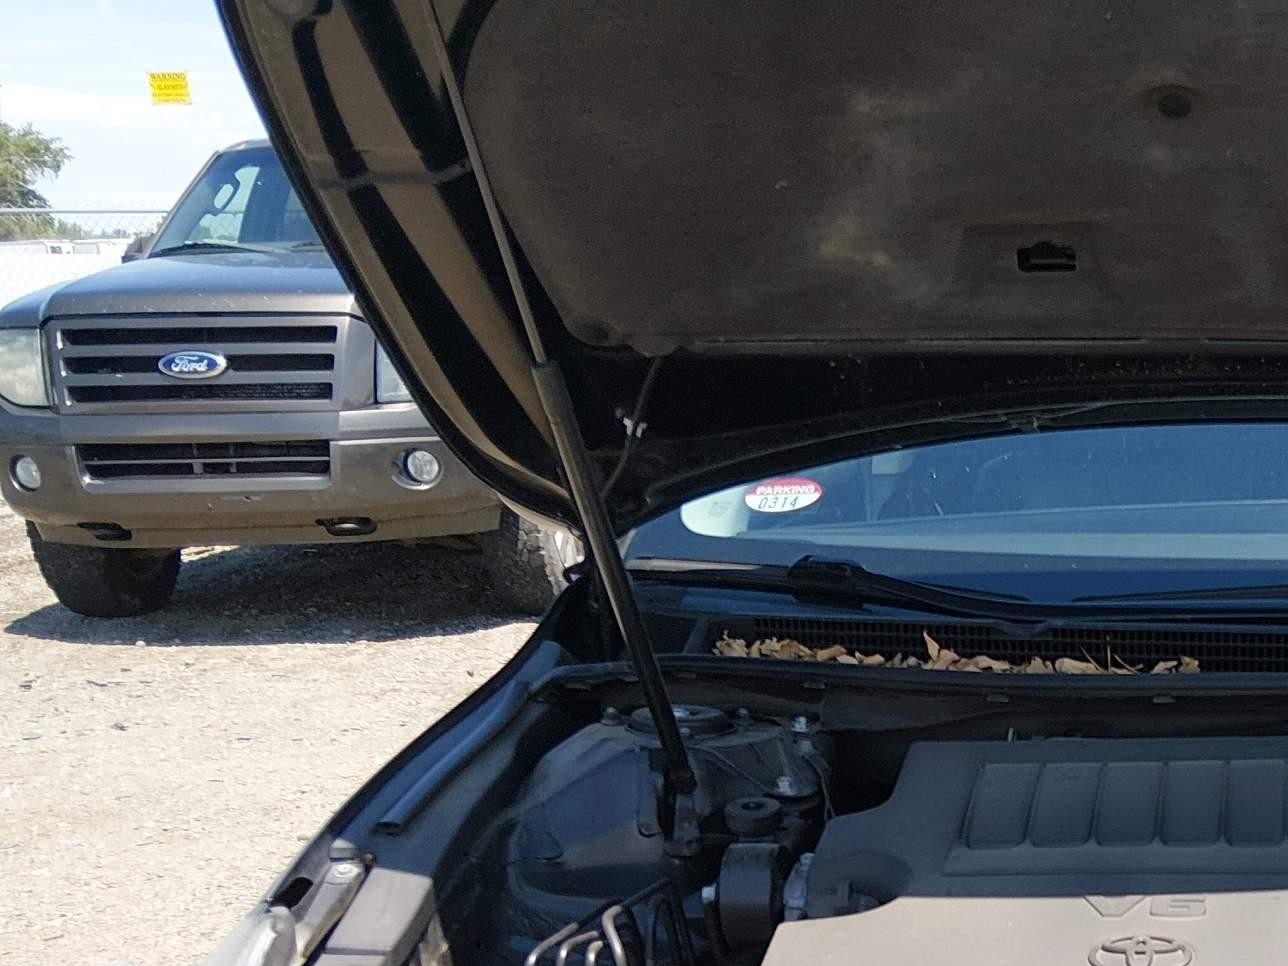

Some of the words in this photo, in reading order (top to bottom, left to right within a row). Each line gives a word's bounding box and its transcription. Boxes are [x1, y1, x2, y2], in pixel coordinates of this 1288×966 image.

[150, 72, 186, 81] WARNING
[171, 355, 208, 372] Ford
[1082, 894, 1207, 917] V6
